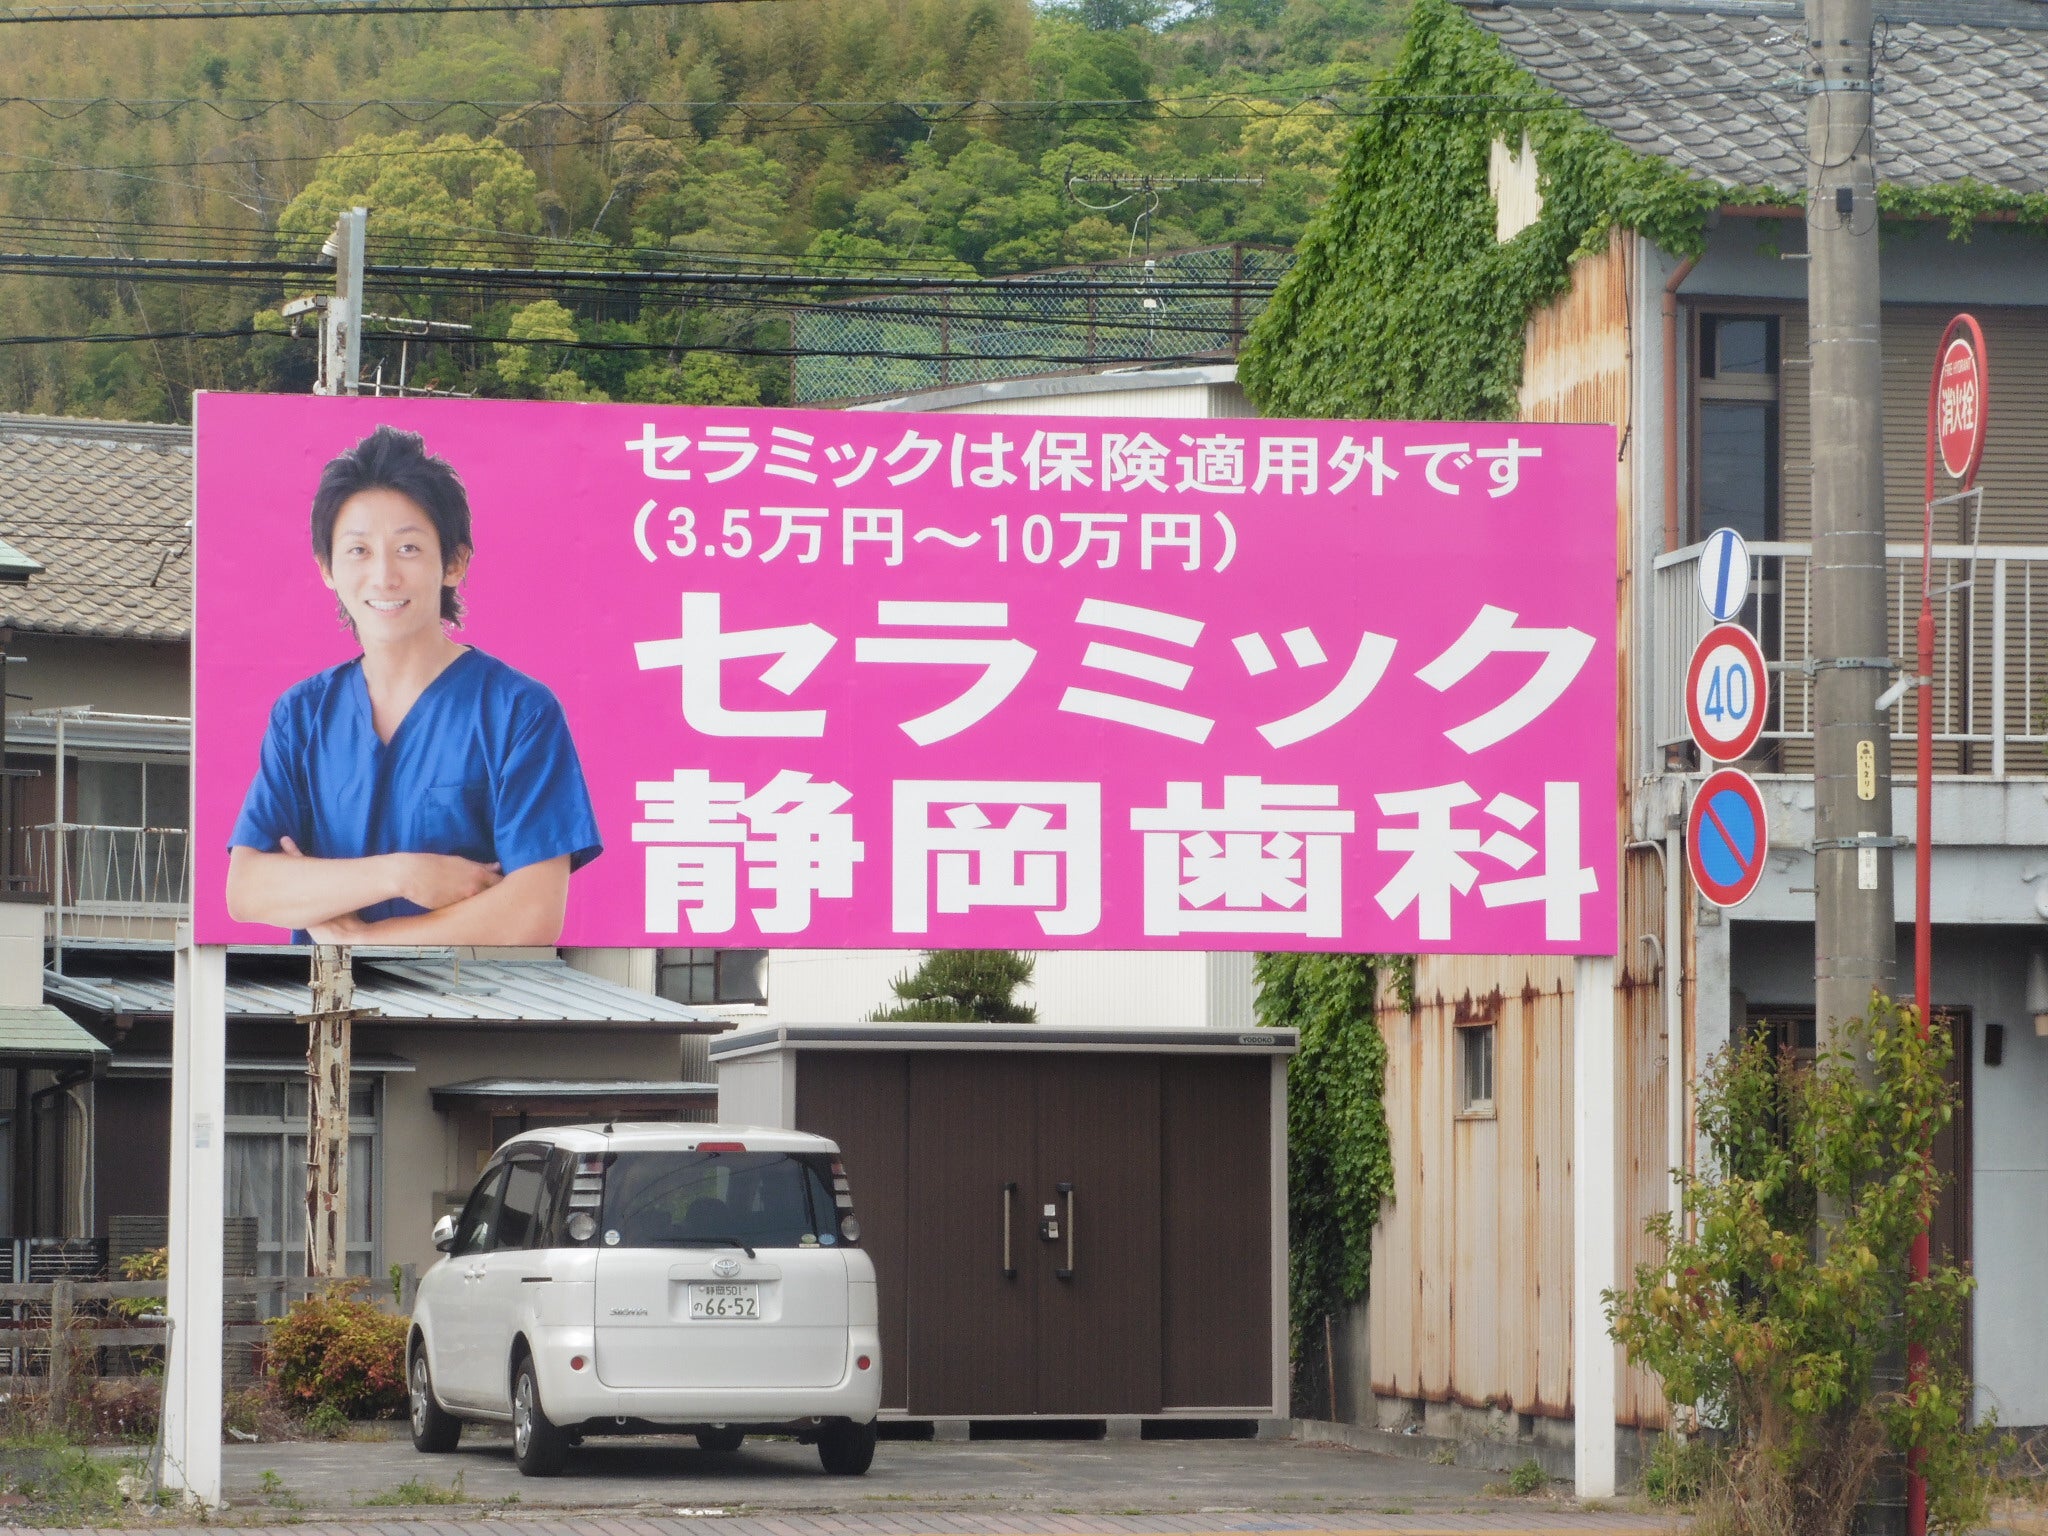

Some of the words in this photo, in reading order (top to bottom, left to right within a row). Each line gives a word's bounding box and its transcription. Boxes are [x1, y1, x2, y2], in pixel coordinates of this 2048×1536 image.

[1942, 380, 1974, 437] 消火栓
[625, 422, 1543, 498] セラミックは保険適用外です
[633, 591, 1597, 755] セラミック
[1704, 663, 1747, 722] 40
[631, 768, 1599, 941] 静岡歯科
